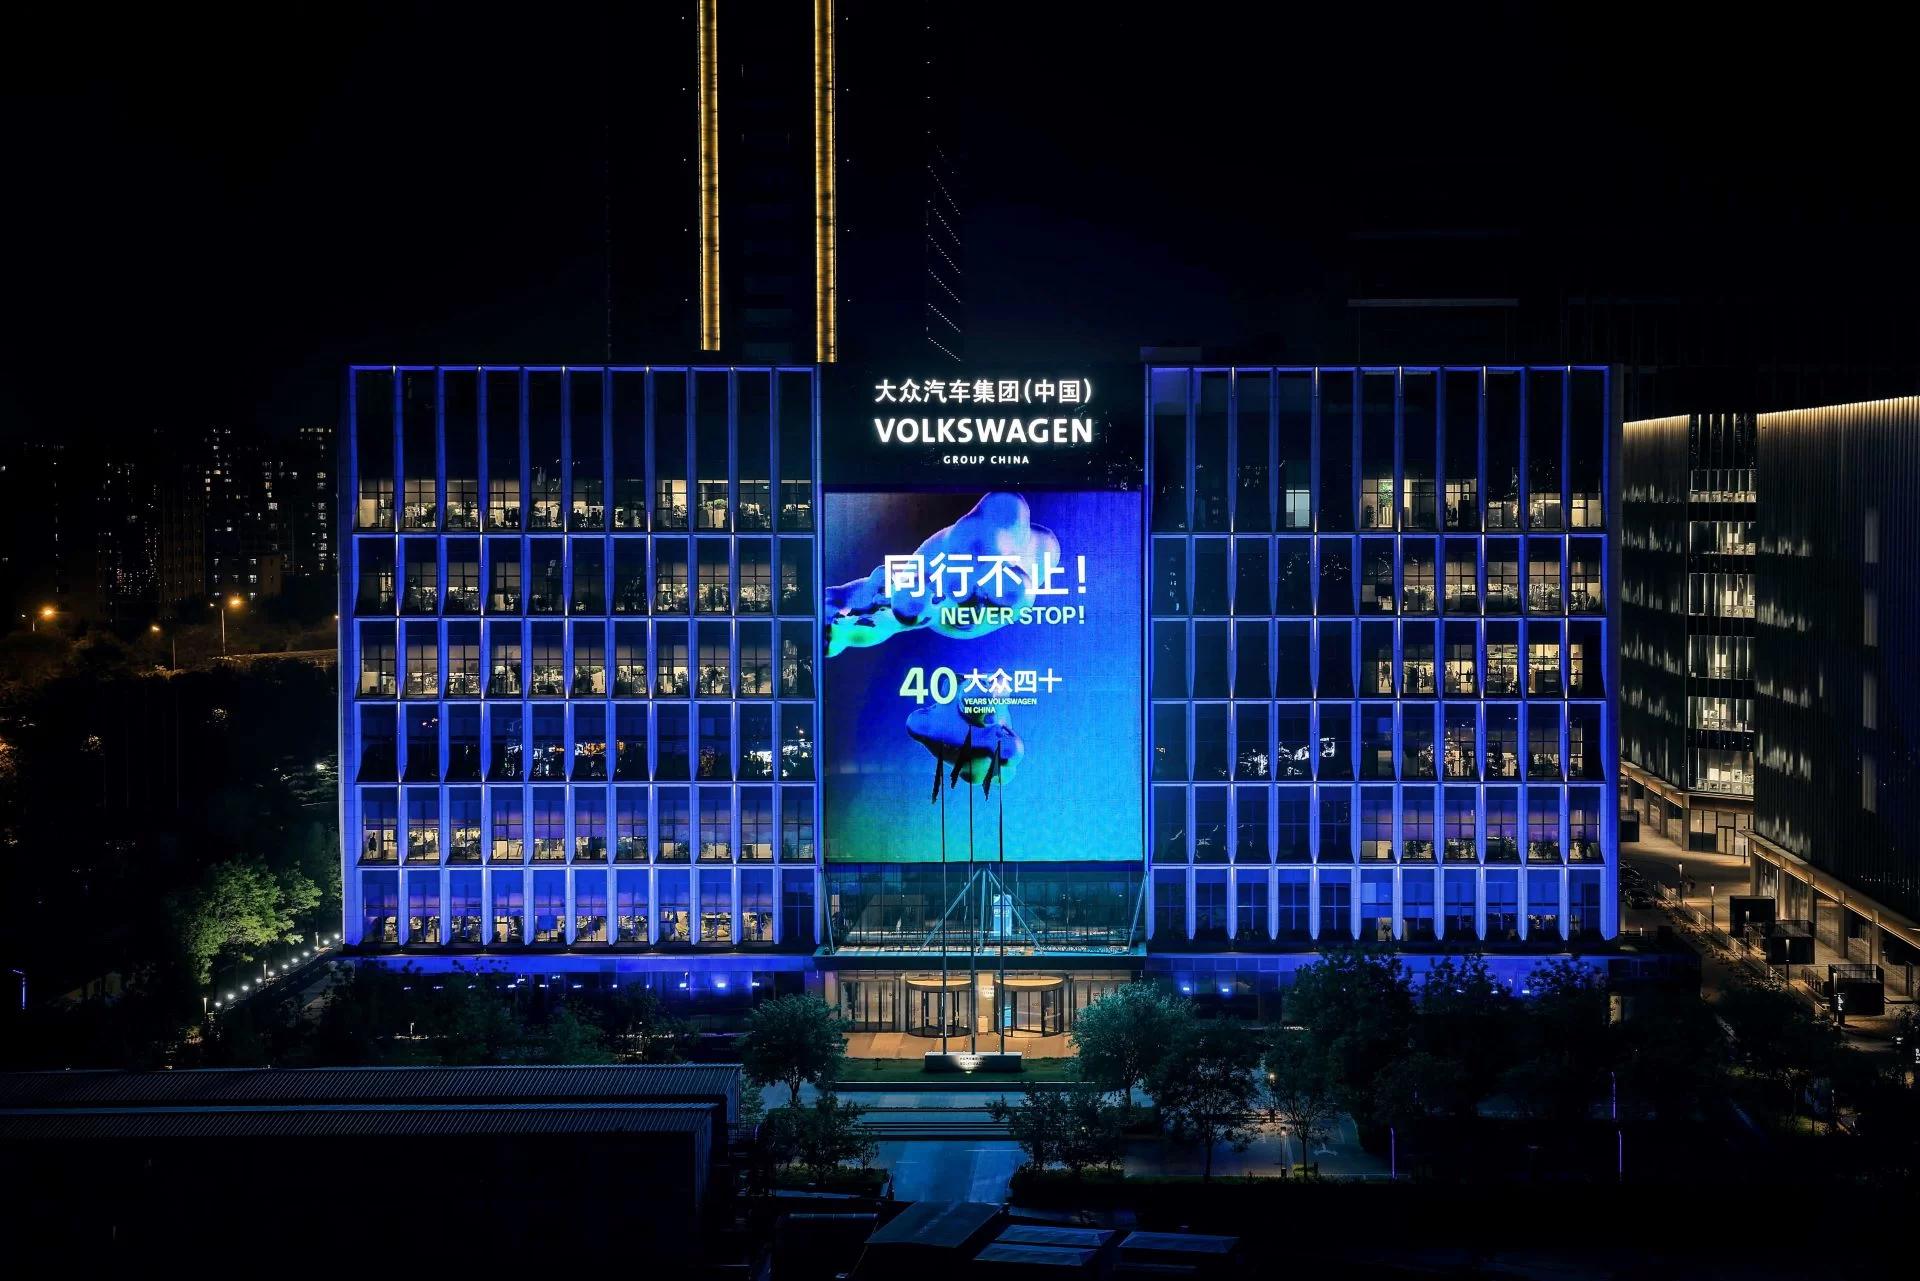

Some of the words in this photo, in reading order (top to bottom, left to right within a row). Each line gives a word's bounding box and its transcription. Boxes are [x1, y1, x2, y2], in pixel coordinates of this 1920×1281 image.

[874, 378, 1093, 404] 大众汽车集团(中国)
[874, 418, 1093, 443] VOLKSWAGEN
[943, 455, 985, 465] GROUP
[990, 455, 1029, 465] CHINA
[884, 551, 1087, 598] 同行不止!
[941, 607, 1013, 625] NEVER
[1019, 606, 1085, 625] STOP!
[899, 667, 958, 705] 40
[963, 668, 1063, 693] 大众四十
